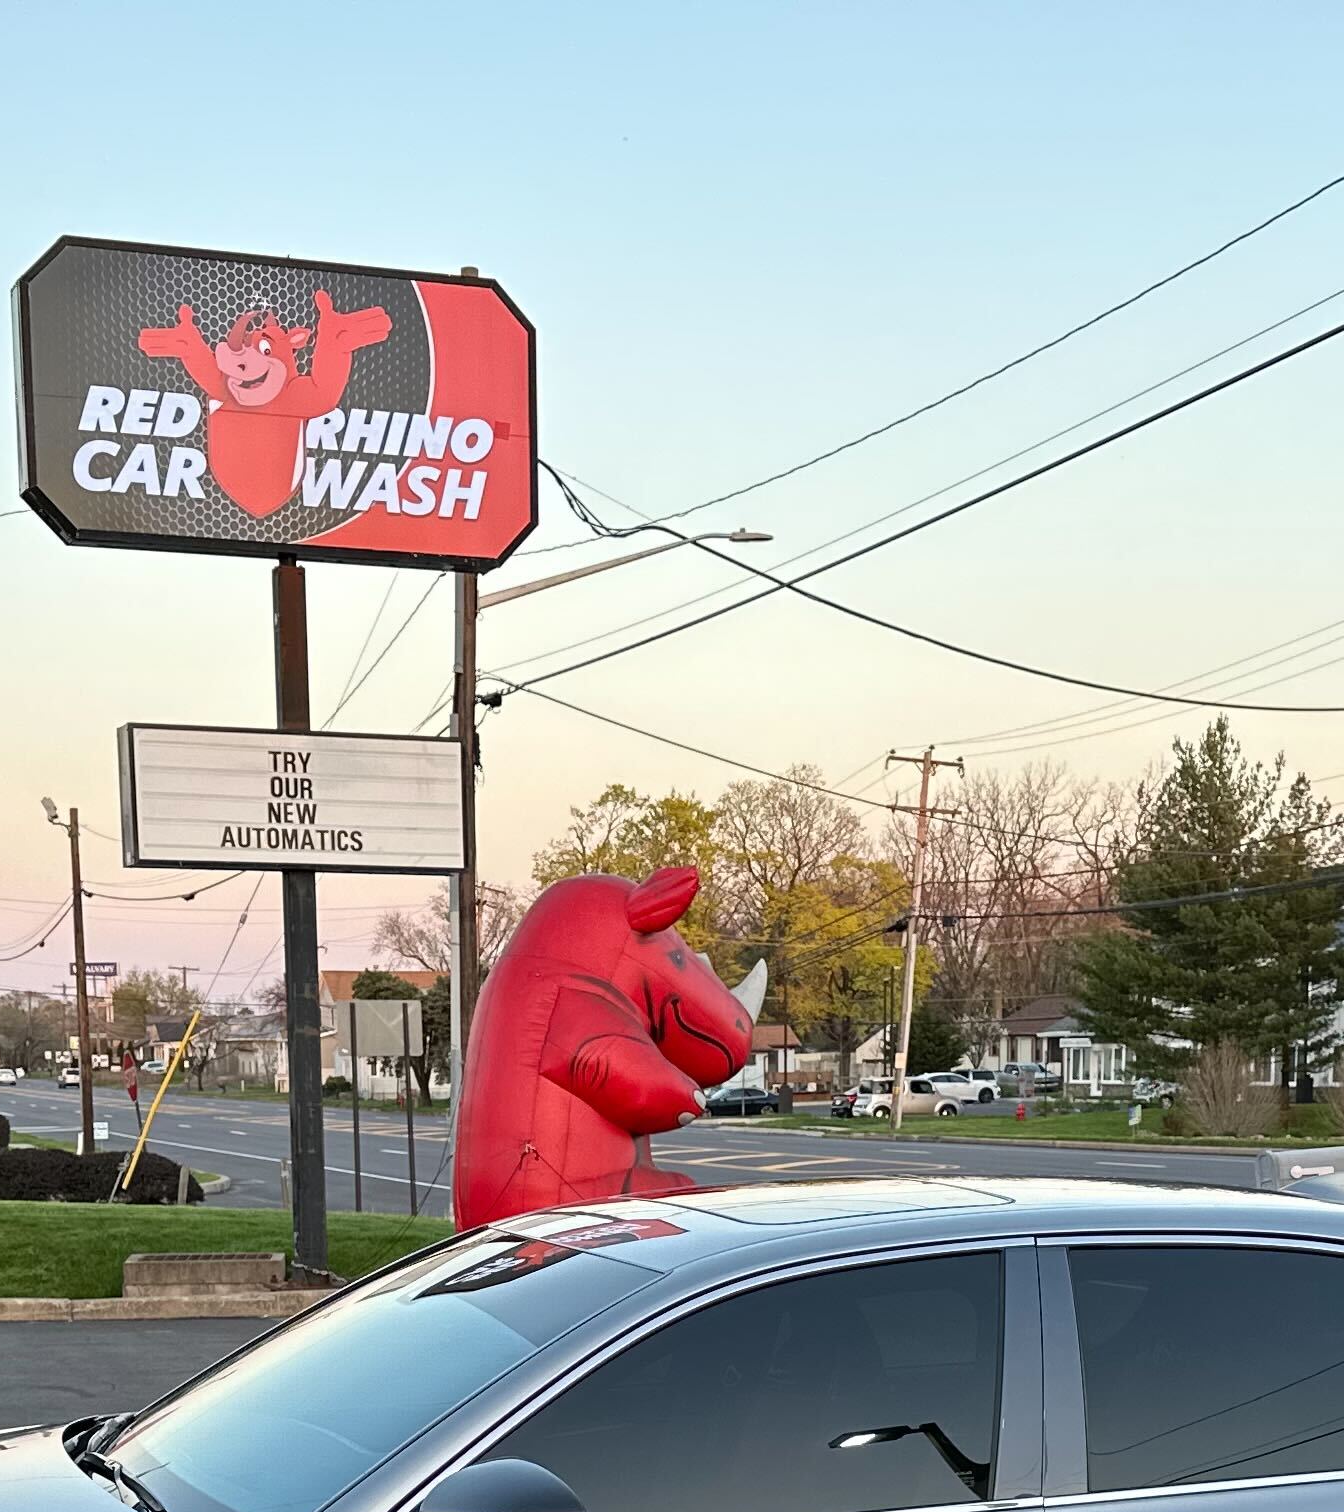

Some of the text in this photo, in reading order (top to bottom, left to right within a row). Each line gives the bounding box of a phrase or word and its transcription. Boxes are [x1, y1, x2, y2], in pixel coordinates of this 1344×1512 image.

[78, 385, 494, 464] RED RHINO
[72, 441, 487, 521] CAR WASH
[267, 750, 312, 774] TRY
[269, 775, 313, 800] OUR
[267, 801, 318, 825] NEW
[220, 825, 364, 852] AUTOMATICS
